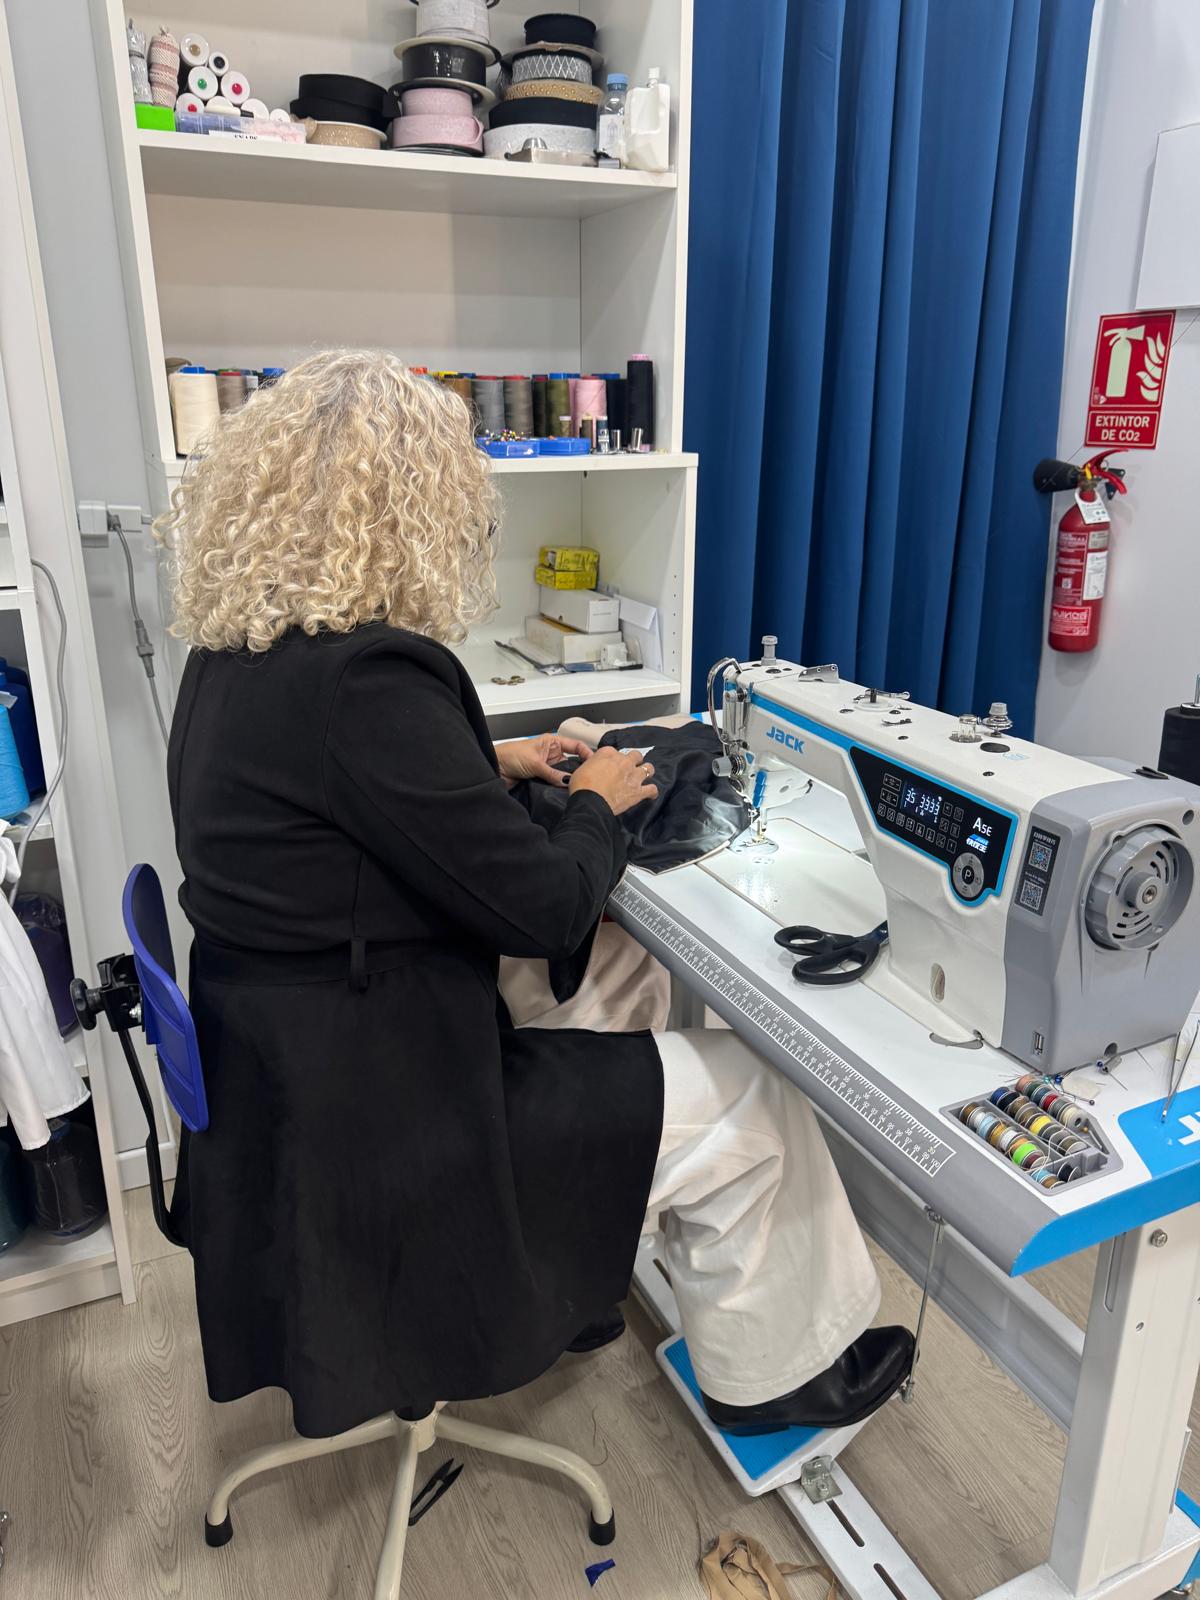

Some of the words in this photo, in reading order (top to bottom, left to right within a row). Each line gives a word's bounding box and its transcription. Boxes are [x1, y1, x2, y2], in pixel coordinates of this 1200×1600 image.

[1095, 415, 1150, 428] EXTINTOR
[1101, 429, 1117, 441] DE
[1119, 429, 1141, 442] CO2
[964, 869, 972, 880] P
